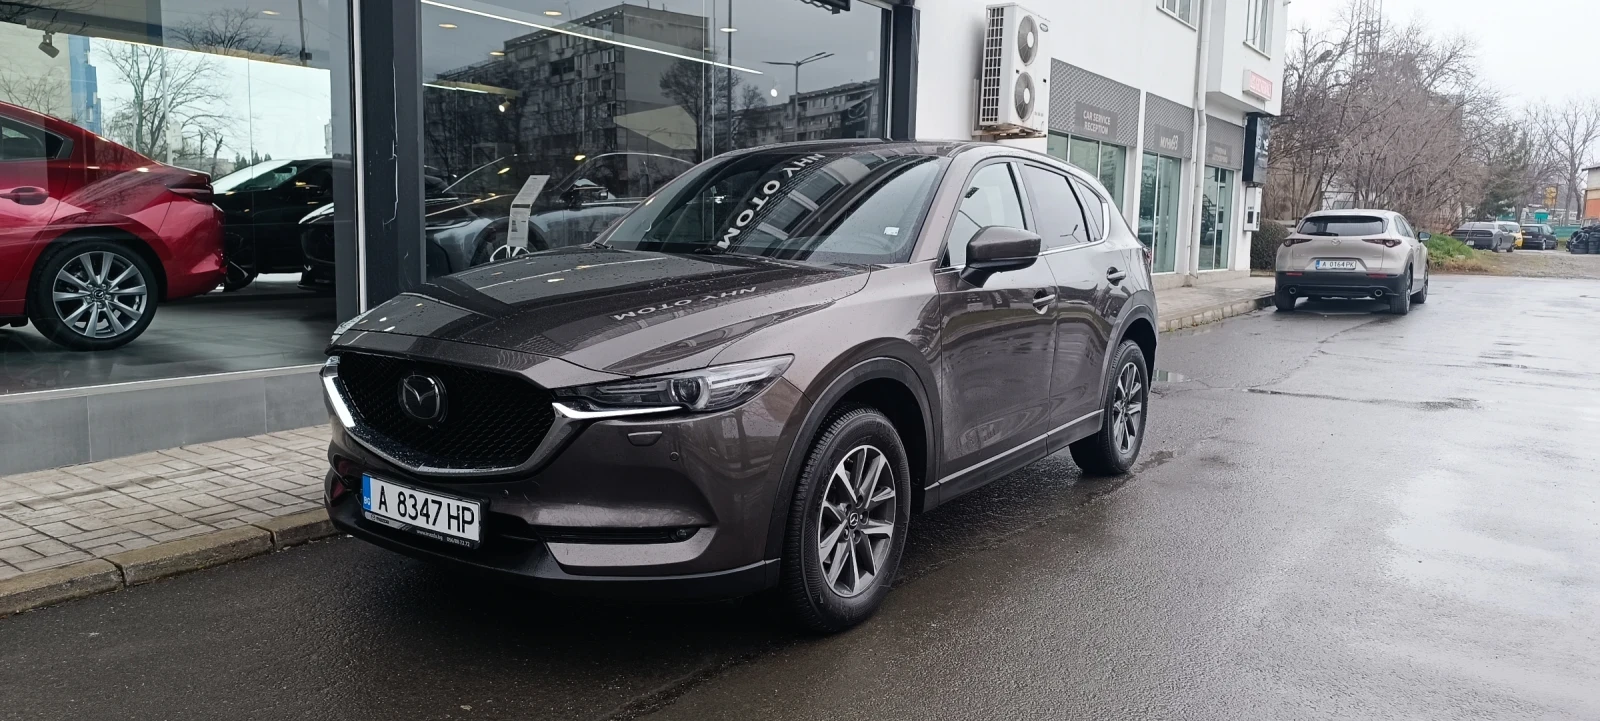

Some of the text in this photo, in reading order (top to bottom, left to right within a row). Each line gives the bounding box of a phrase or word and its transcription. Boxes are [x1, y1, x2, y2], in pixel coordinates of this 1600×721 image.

[1083, 110, 1110, 125] CAR SERVICE
[1084, 121, 1108, 134] RECEPTION
[363, 496, 371, 506] BG
[378, 485, 475, 533] A 8347 HP
